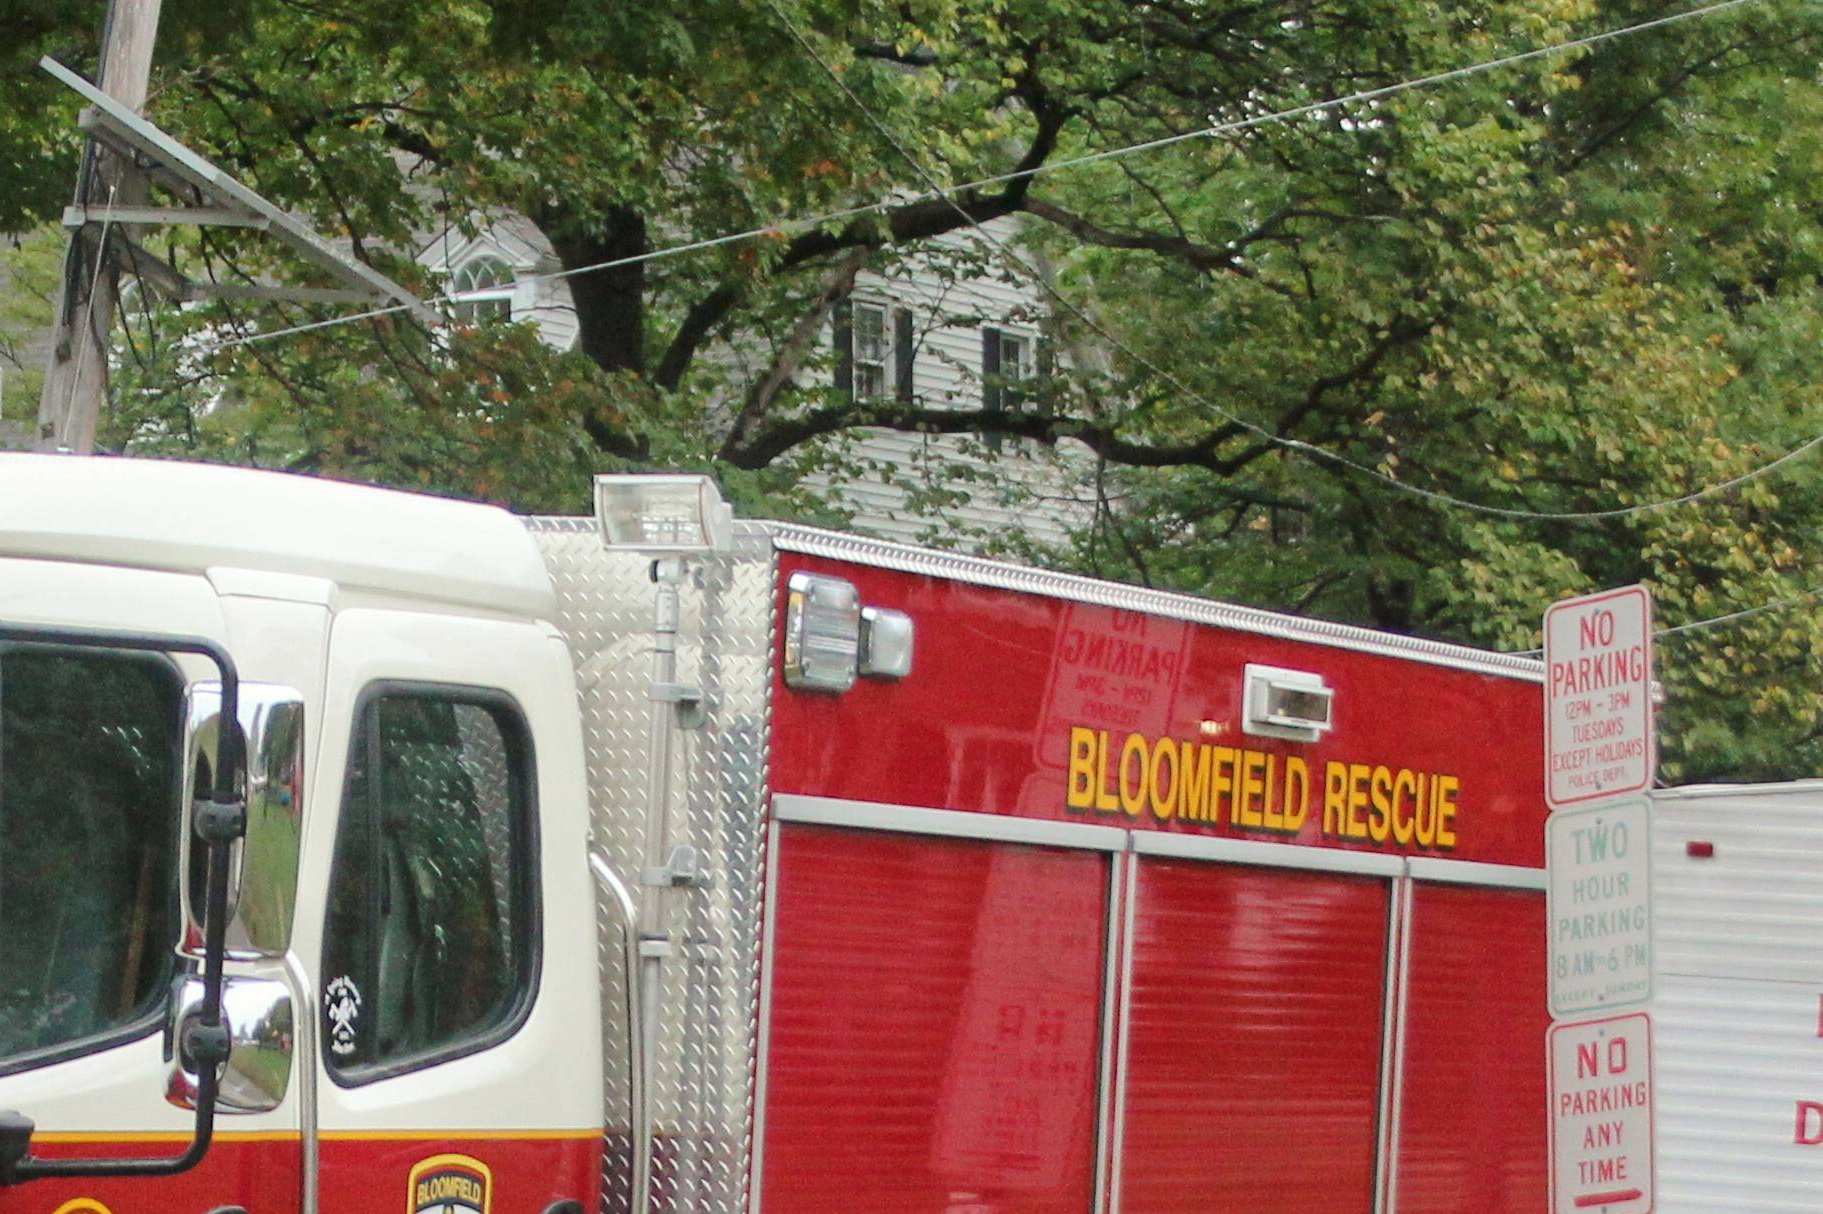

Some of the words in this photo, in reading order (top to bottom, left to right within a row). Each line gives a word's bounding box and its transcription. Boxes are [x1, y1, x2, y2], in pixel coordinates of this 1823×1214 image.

[1580, 609, 1614, 650] NO
[1552, 646, 1643, 698] PARKING
[1566, 699, 1591, 720] 12PM
[1609, 691, 1630, 712] 3PM
[1571, 716, 1624, 743] TUESDAYS
[1553, 747, 1591, 772] EXCEPT
[1595, 738, 1643, 763] HOLIDAYS
[1067, 726, 1311, 834] BLOOMFIELD
[1322, 761, 1460, 849] RESCUE
[1571, 821, 1627, 865] TWO
[1572, 872, 1629, 904] HOUR
[1558, 905, 1645, 942] PARKING
[1557, 953, 1568, 980] 8
[1573, 951, 1594, 976] AM
[1607, 946, 1619, 972] 6
[1624, 944, 1646, 969] PM
[1578, 1037, 1626, 1078] NO
[1560, 1082, 1647, 1117] PARKING
[1583, 1121, 1623, 1150] ANY
[1579, 1156, 1626, 1185] TIME
[417, 1175, 481, 1205] BLOOMFIELD
